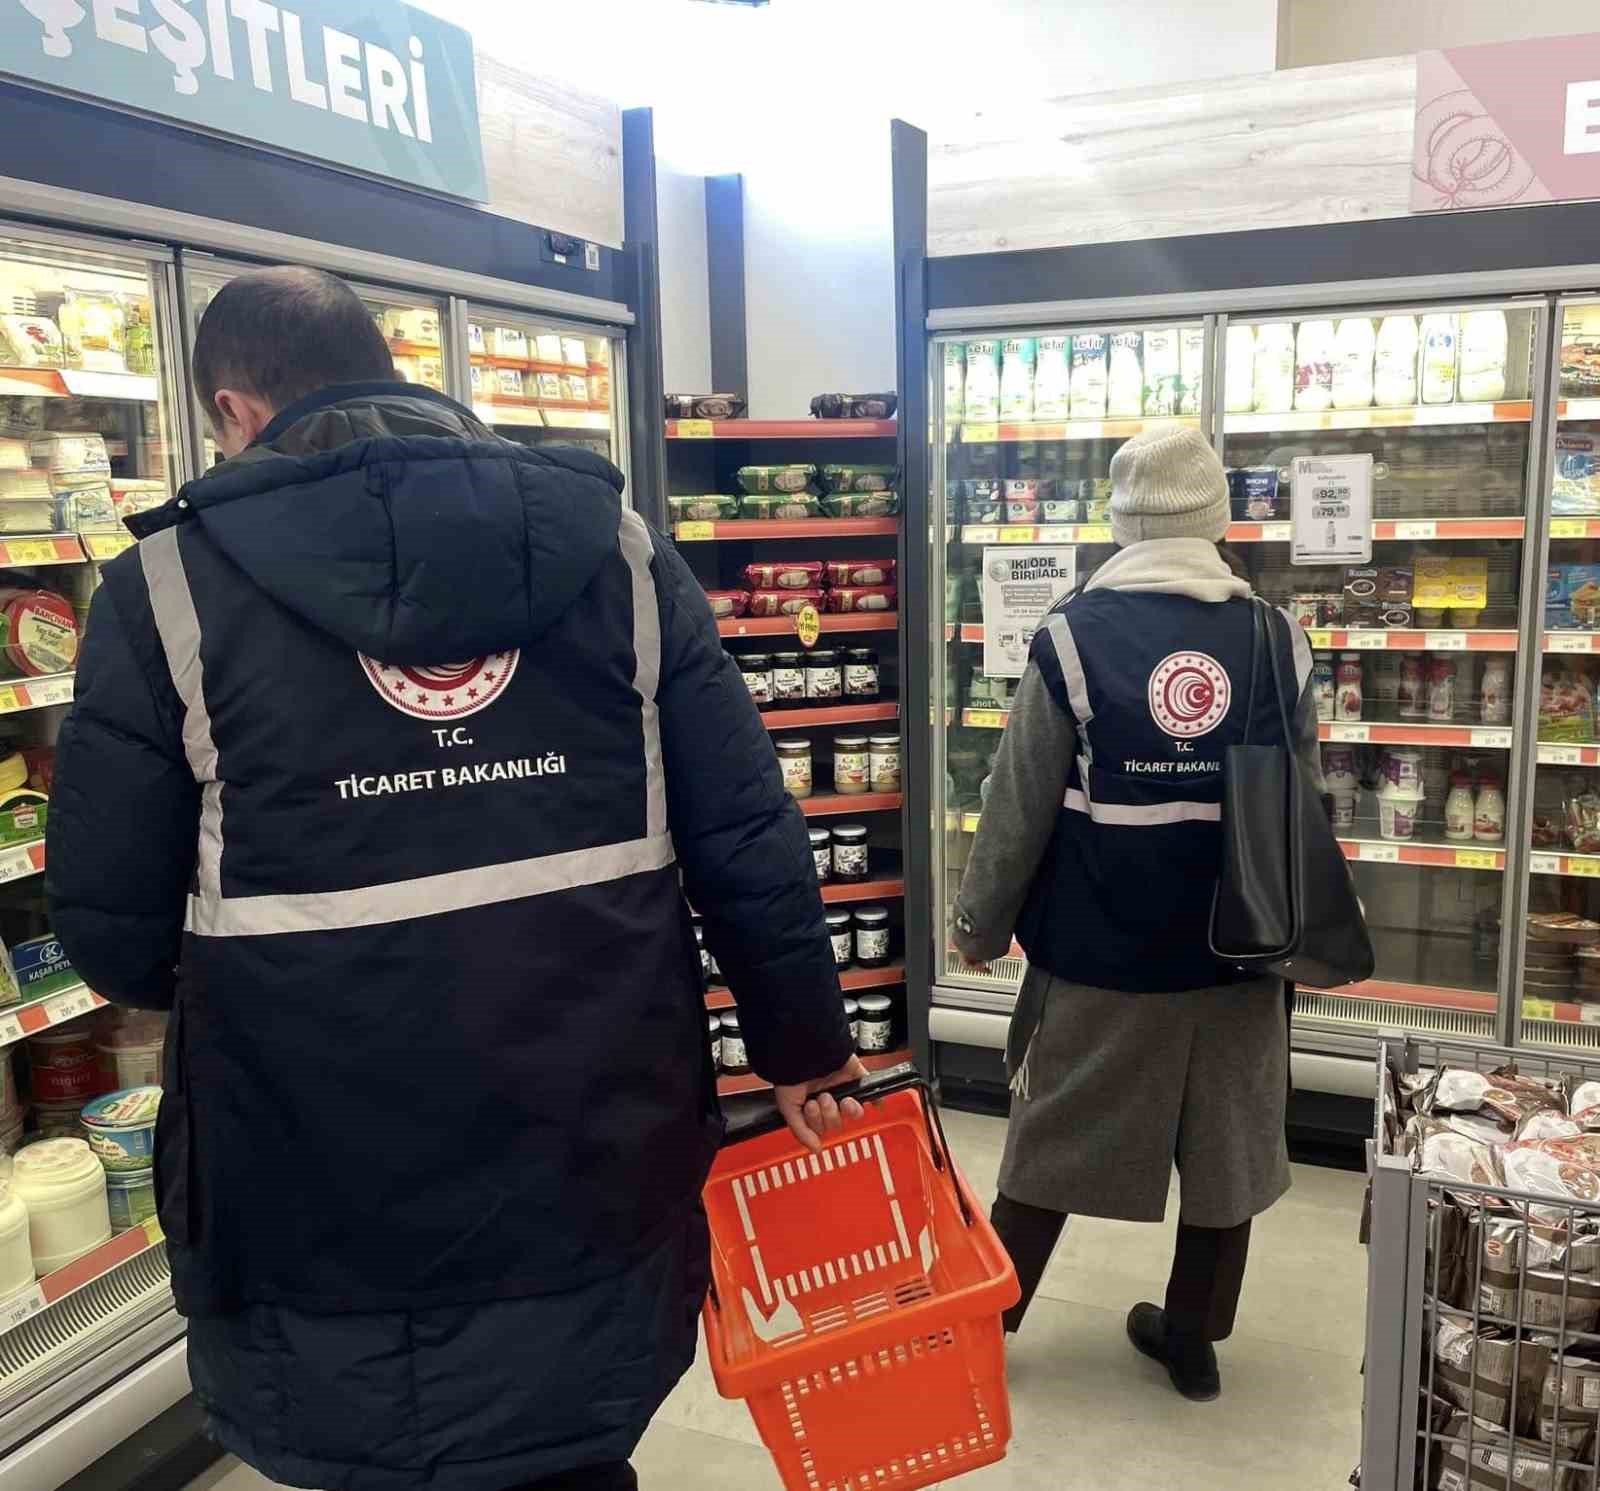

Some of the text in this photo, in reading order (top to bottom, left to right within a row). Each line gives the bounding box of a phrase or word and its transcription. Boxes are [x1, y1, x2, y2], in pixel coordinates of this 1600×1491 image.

[432, 728, 473, 747] T.C.
[1174, 741, 1194, 752] T.C.
[1124, 759, 1175, 773] TİCARET
[334, 752, 566, 800] TİCARET BAKANLIĞI
